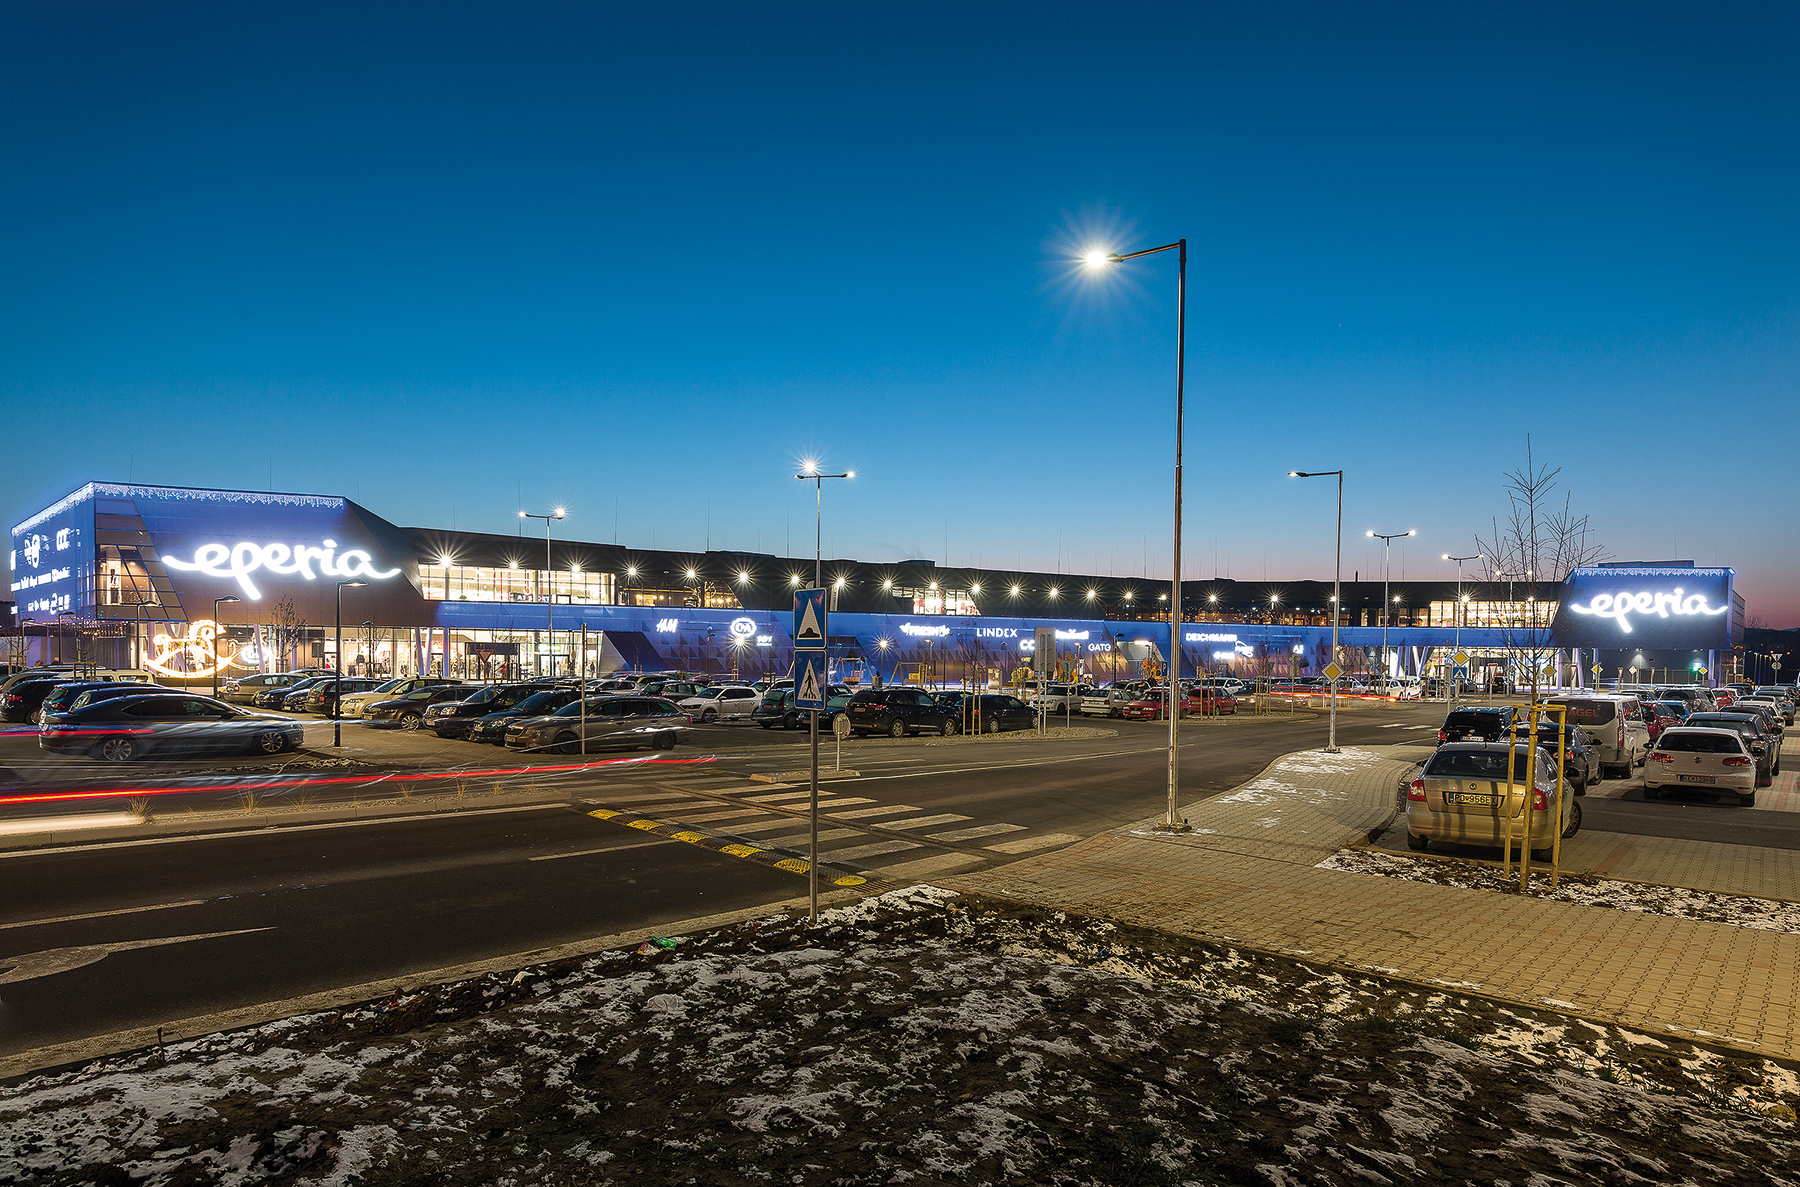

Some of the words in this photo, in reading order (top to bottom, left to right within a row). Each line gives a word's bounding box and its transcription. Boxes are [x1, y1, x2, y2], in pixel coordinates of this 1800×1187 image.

[161, 539, 401, 600] eperia
[1571, 588, 1728, 633] eperia
[976, 627, 1018, 638] LINDEX
[1185, 632, 1238, 642] DEICHMANN
[1469, 795, 1497, 805] 956EX
